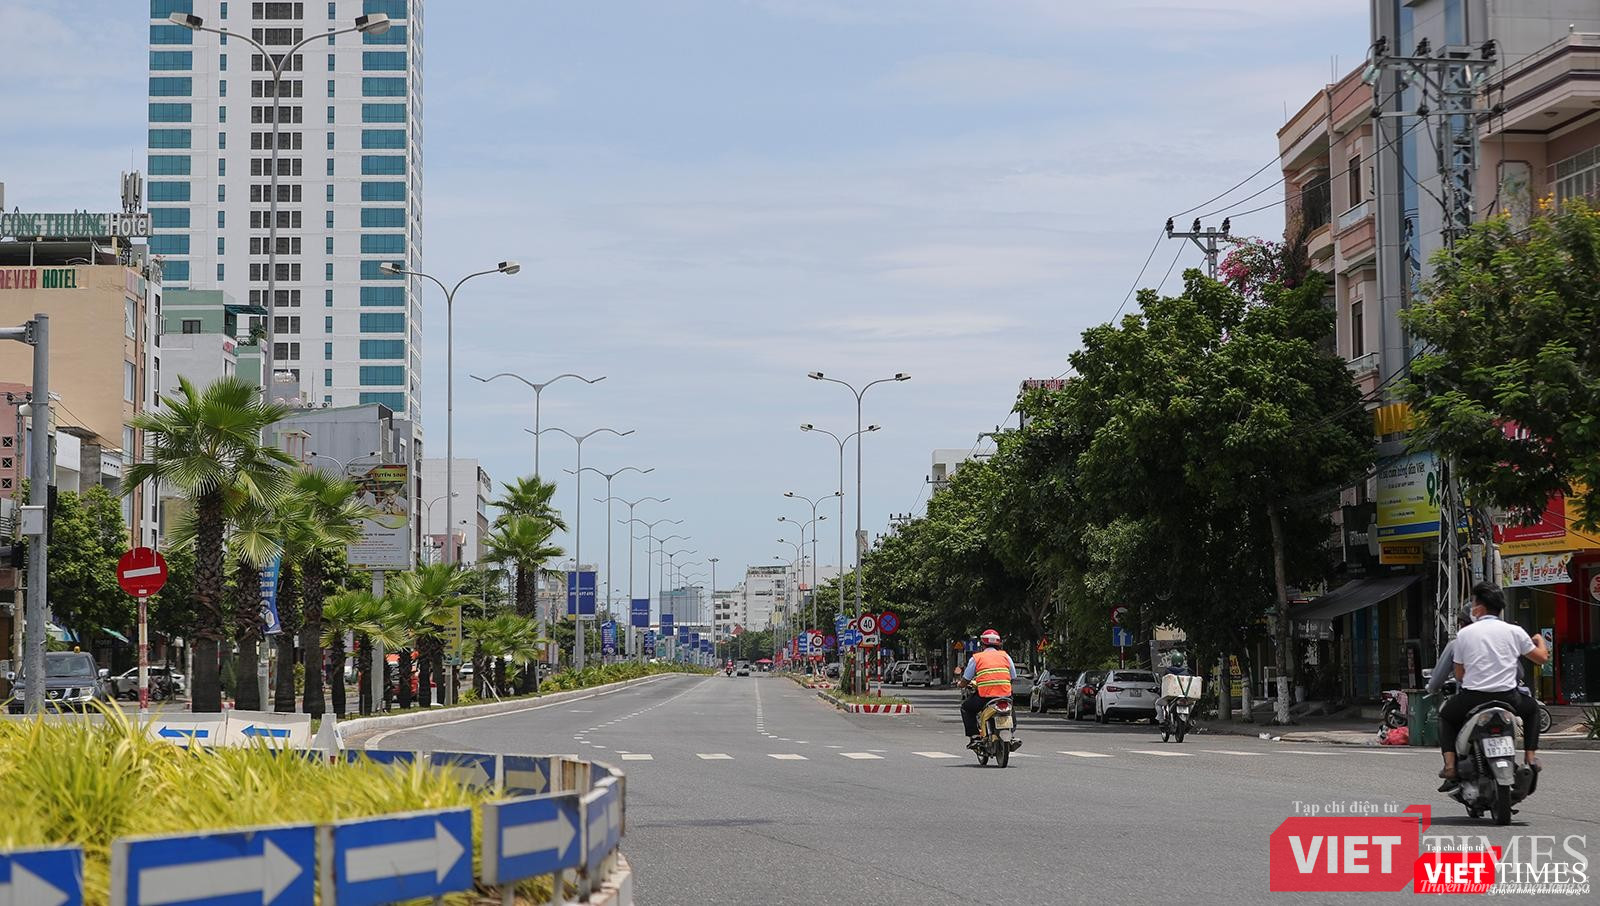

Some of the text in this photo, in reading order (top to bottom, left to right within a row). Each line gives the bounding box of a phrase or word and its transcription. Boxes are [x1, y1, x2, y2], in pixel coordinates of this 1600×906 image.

[110, 213, 152, 237] Hotel
[42, 269, 77, 289] HOTEL
[863, 619, 873, 628] 40
